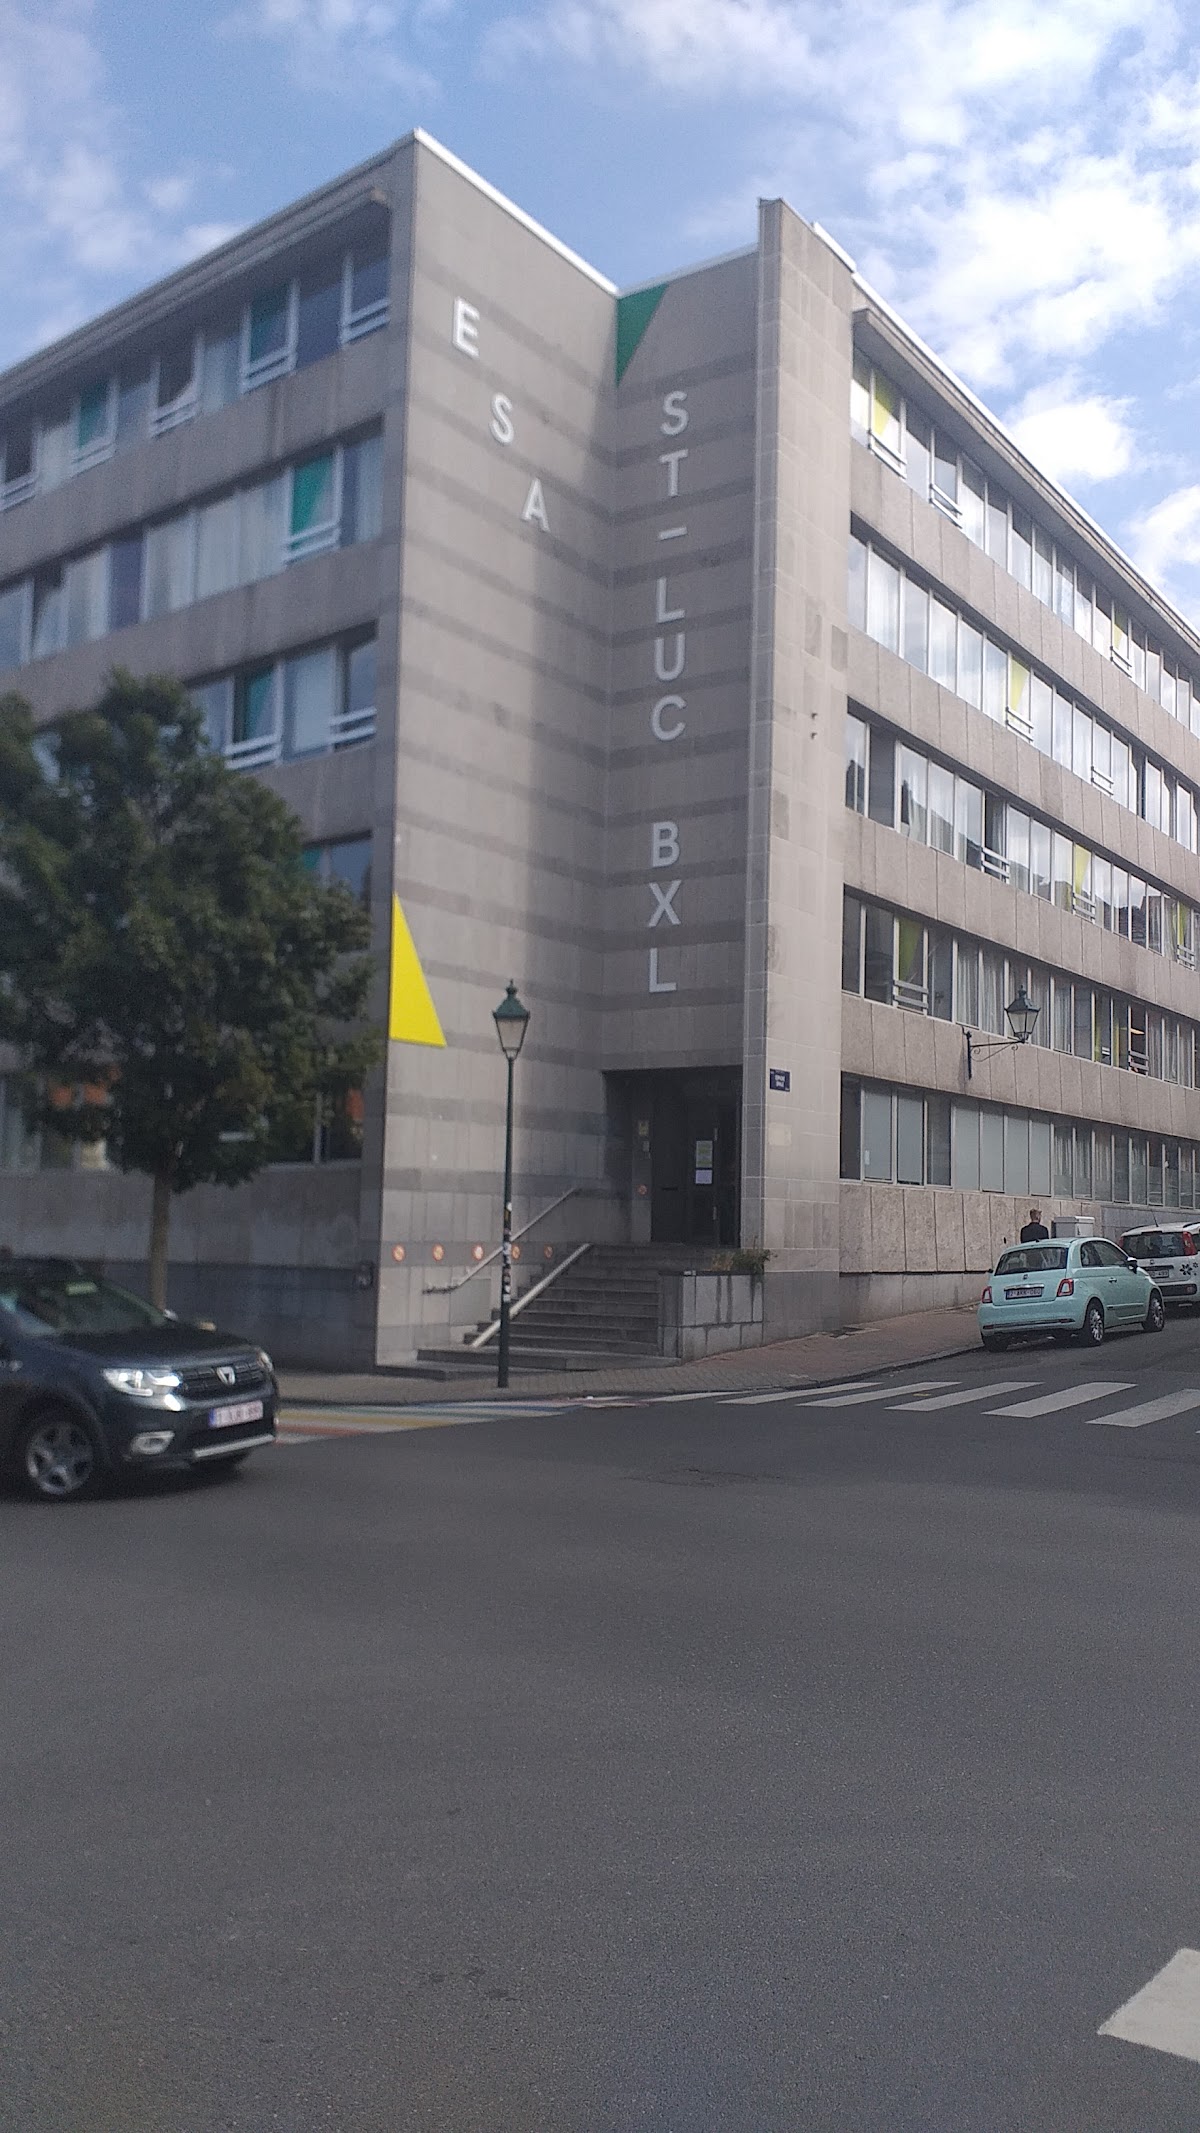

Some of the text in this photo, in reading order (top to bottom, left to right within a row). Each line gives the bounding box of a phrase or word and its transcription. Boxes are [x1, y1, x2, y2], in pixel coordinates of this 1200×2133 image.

[452, 297, 549, 532] ESA
[649, 390, 689, 993] ST-LUC BXL
